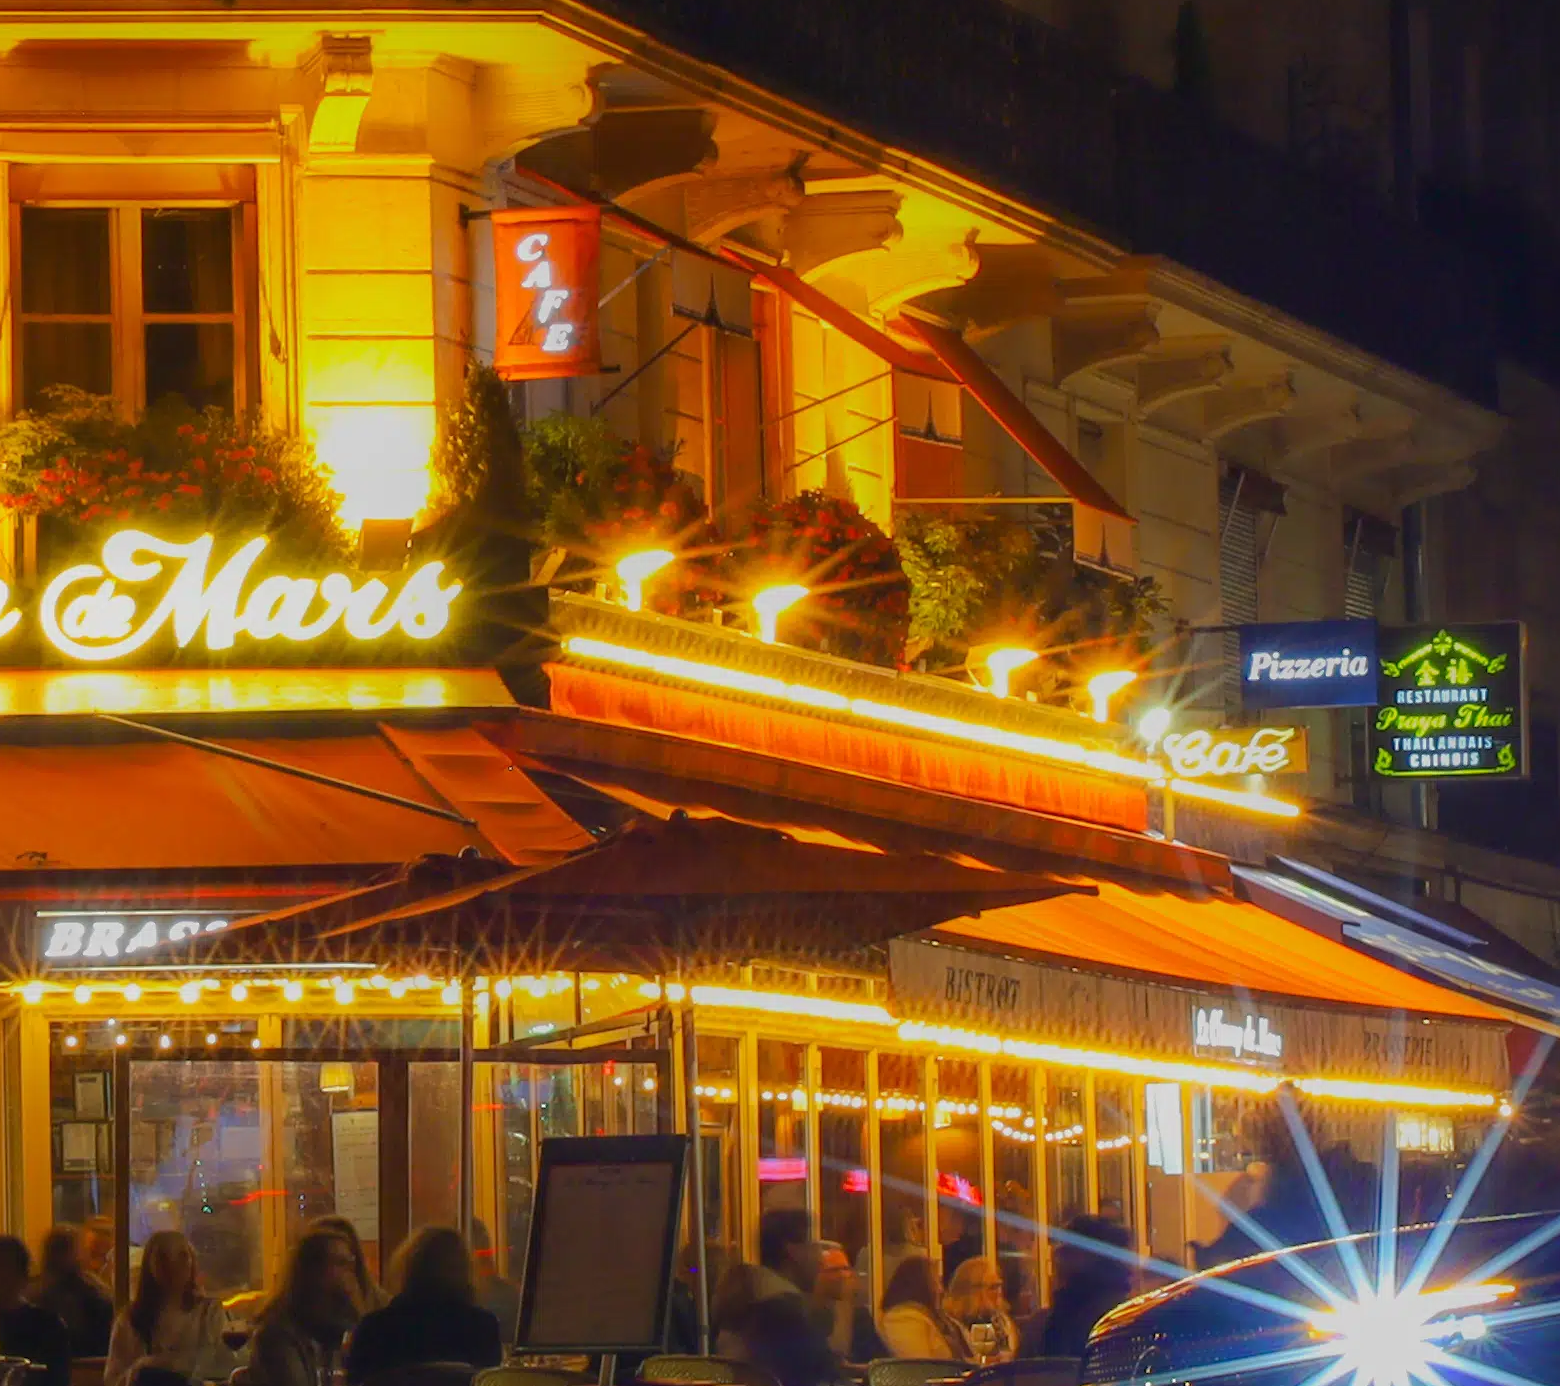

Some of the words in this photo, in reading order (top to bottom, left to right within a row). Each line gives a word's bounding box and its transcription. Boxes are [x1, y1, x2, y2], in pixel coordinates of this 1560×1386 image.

[516, 233, 574, 352] CAFE
[40, 528, 464, 661] Mars
[61, 577, 138, 640] de
[1247, 647, 1370, 682] Pizzeria
[1396, 687, 1489, 705] RESTAURANT
[1376, 706, 1447, 738] Praya
[1163, 727, 1295, 778] Café
[1392, 735, 1494, 753] THAILANDAIS
[1409, 751, 1480, 769] CHINOIS
[944, 966, 1021, 1011] BISTROT
